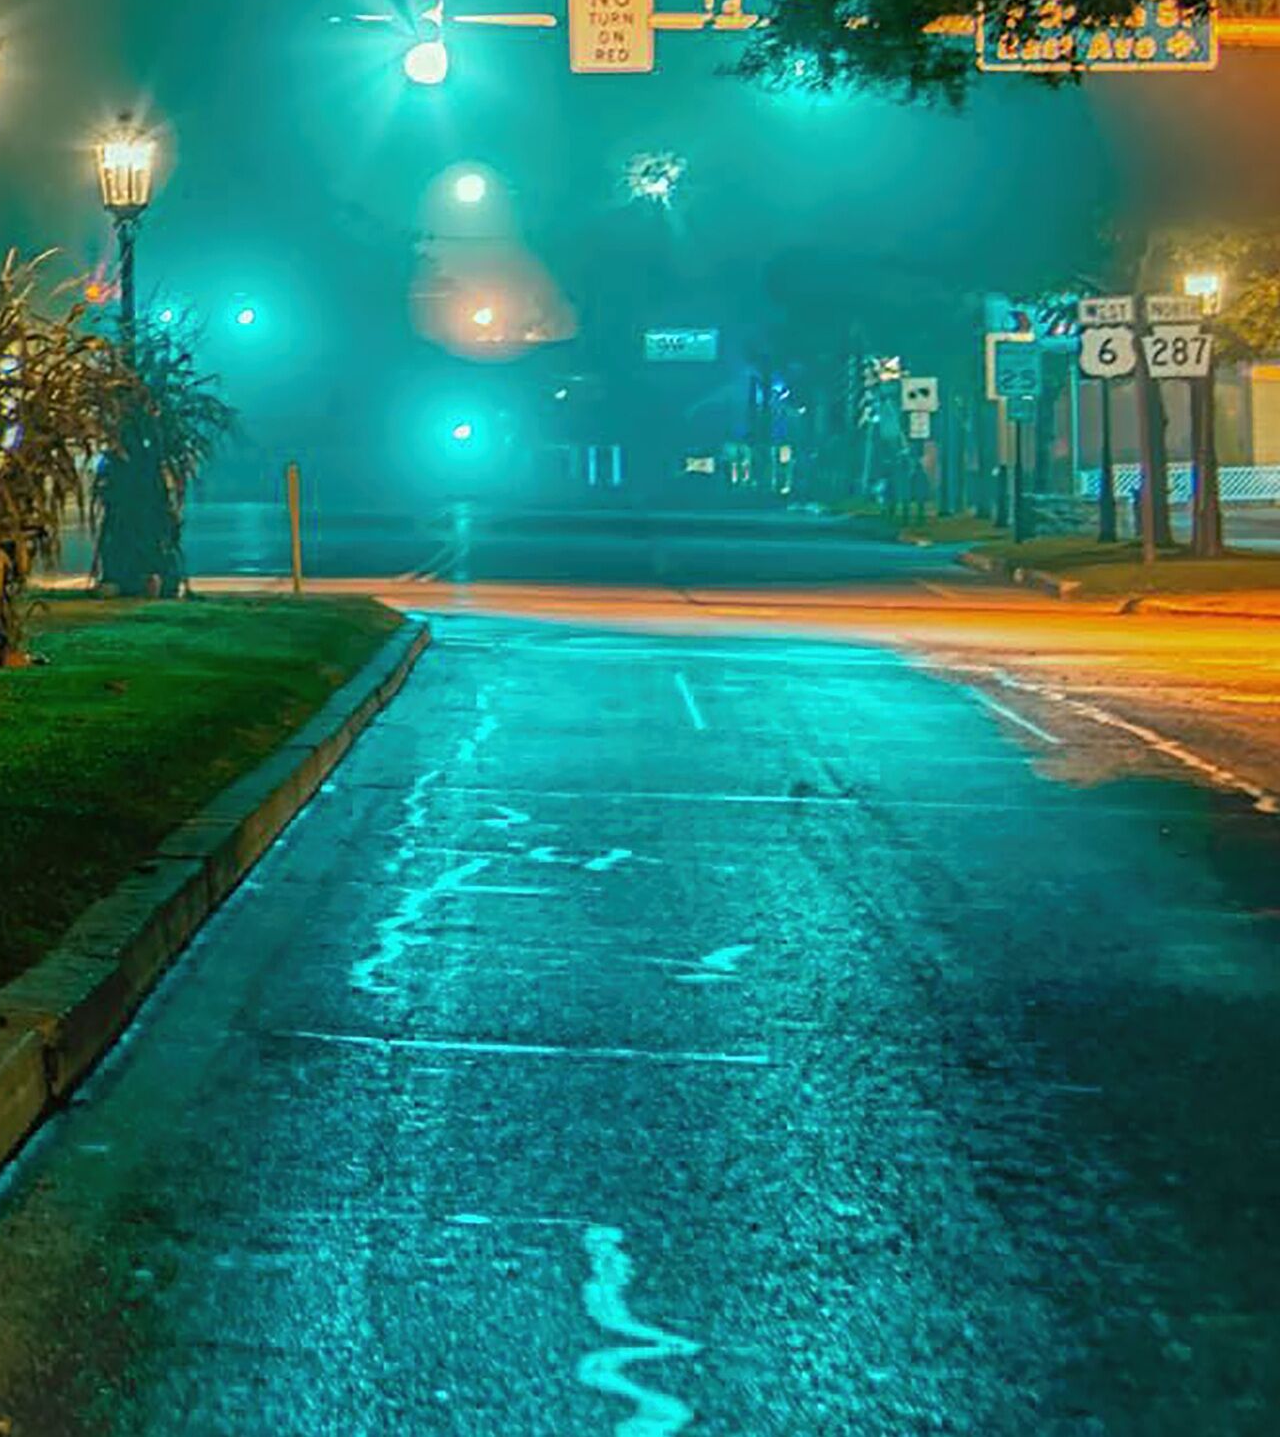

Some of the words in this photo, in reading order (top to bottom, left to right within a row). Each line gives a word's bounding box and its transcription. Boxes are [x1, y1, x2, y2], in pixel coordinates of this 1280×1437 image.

[588, 12, 634, 26] TURN
[598, 30, 625, 44] ON
[1087, 31, 1157, 60] Ave
[594, 48, 630, 63] RED
[1098, 336, 1118, 365] 6
[1151, 336, 1207, 367] 287
[999, 368, 1038, 390] 25
